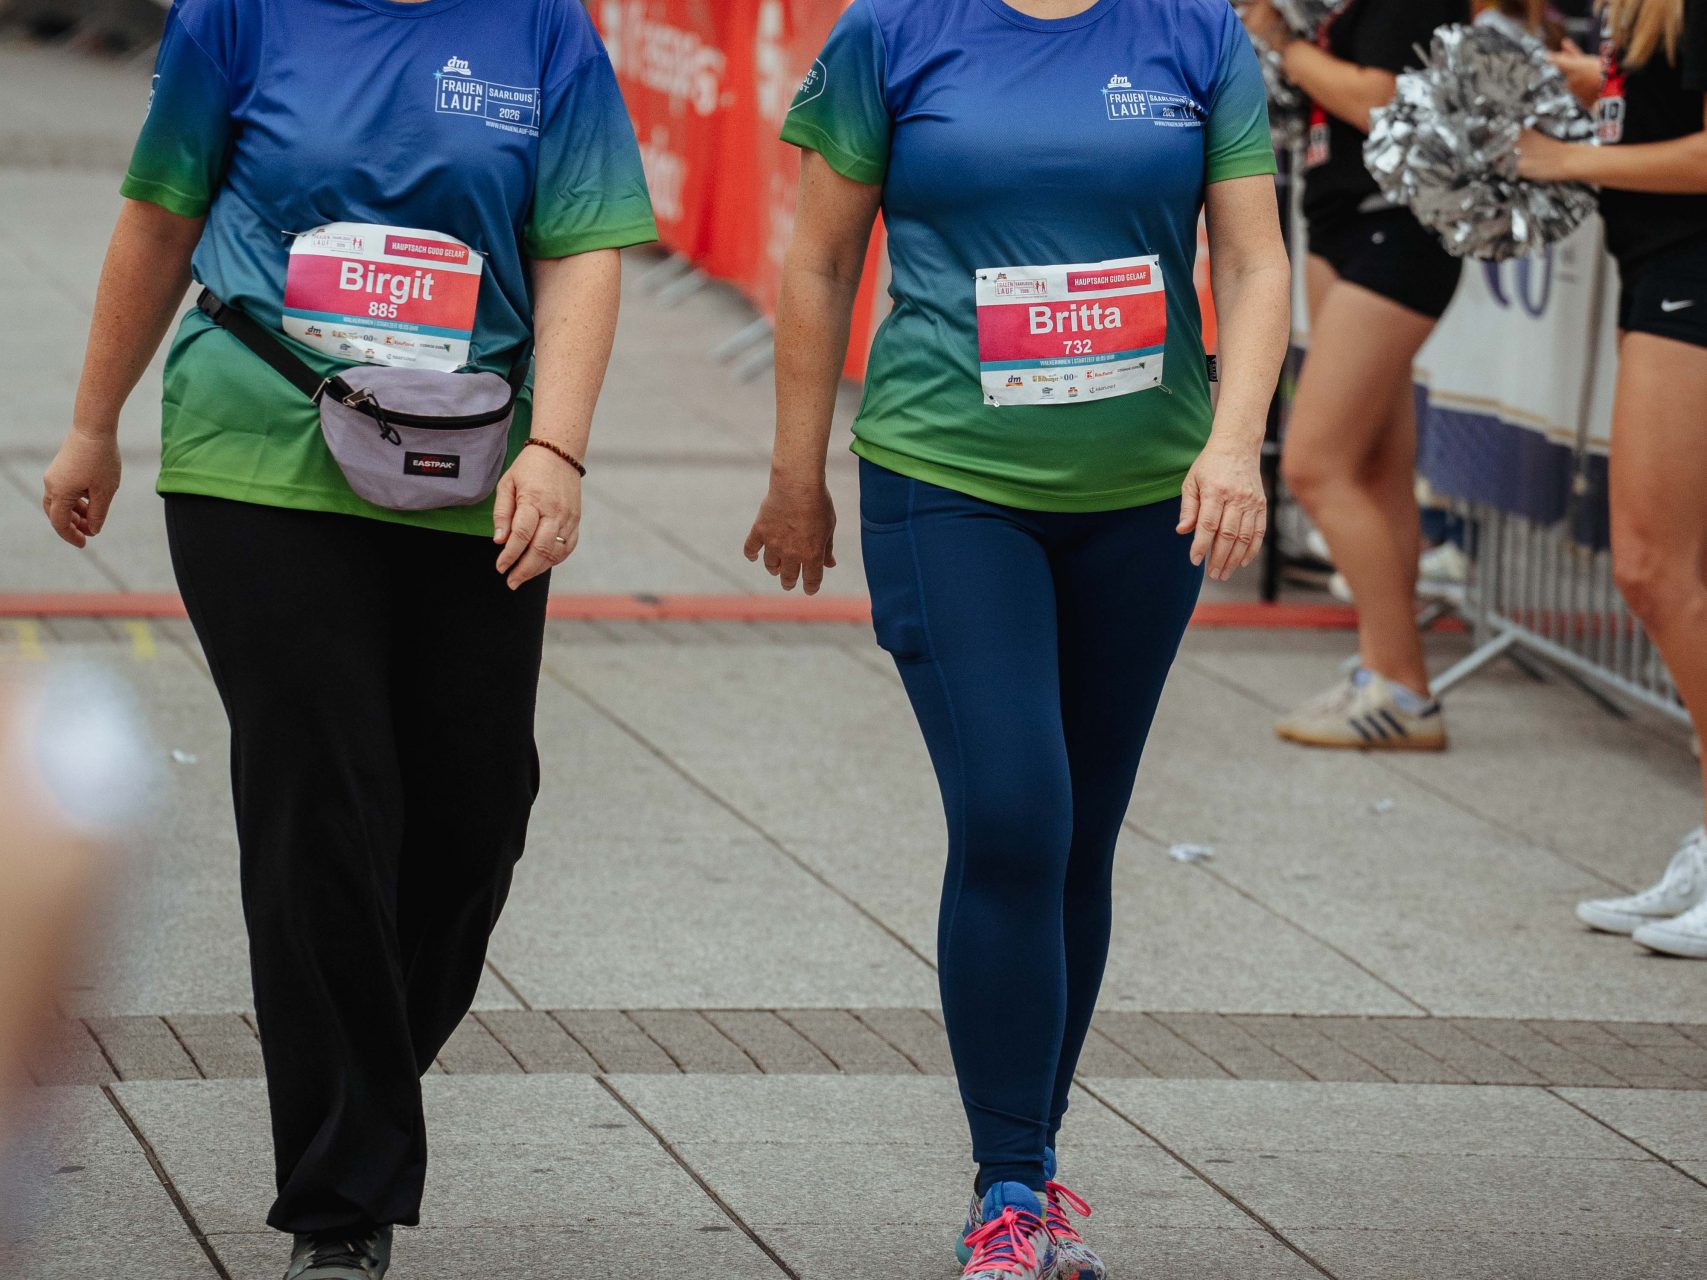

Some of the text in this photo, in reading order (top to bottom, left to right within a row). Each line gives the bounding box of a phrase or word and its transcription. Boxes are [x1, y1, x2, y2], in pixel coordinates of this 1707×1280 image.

[447, 55, 469, 69] dm
[1110, 74, 1128, 84] dm
[442, 79, 483, 96] FRAUEN
[488, 87, 533, 103] SAARLOUIS
[1109, 93, 1145, 103] FRAUEN
[441, 93, 482, 112] LAUF
[1111, 103, 1147, 117] LAUF
[391, 241, 428, 254] HAUPTSACH
[339, 260, 435, 304] Birgit
[1074, 276, 1109, 286] HAUPTSACH
[368, 301, 398, 319] 885
[1028, 302, 1122, 335] Britta
[307, 325, 322, 334] dm
[1063, 339, 1093, 355] 732
[1007, 375, 1022, 383] dm
[412, 459, 453, 469] EASTPAK
